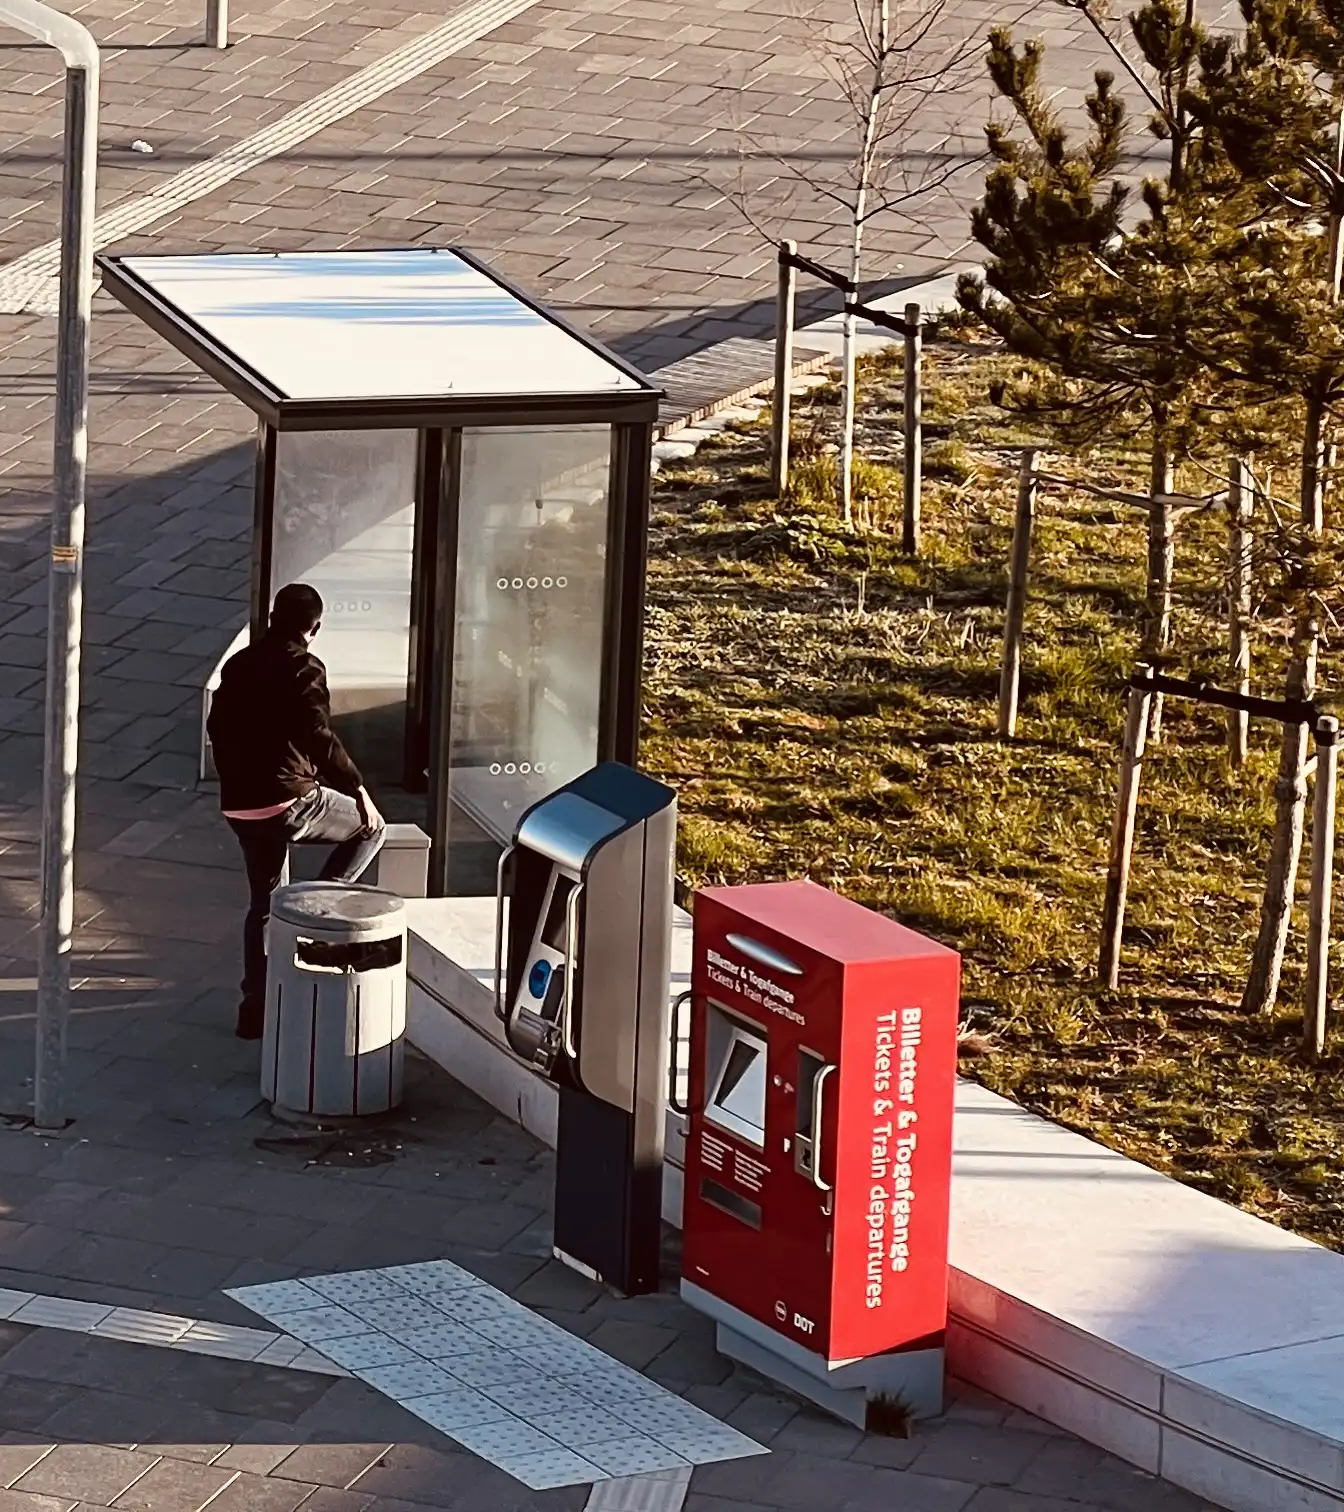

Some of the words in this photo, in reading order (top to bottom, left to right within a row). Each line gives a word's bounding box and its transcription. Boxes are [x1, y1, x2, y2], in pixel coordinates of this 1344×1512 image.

[707, 964, 734, 990] Tickets
[735, 979, 741, 993] &
[743, 983, 762, 1004] Train
[763, 995, 806, 1026] departures
[740, 966, 747, 979] &
[874, 1009, 897, 1093] Tickets
[898, 1007, 922, 1105] Billetter
[873, 1099, 894, 1117] &
[897, 1110, 918, 1130] &
[871, 1121, 893, 1179] Train
[889, 1132, 917, 1273] Togafgange
[865, 1185, 890, 1309] departures
[794, 1313, 815, 1335] DOT
